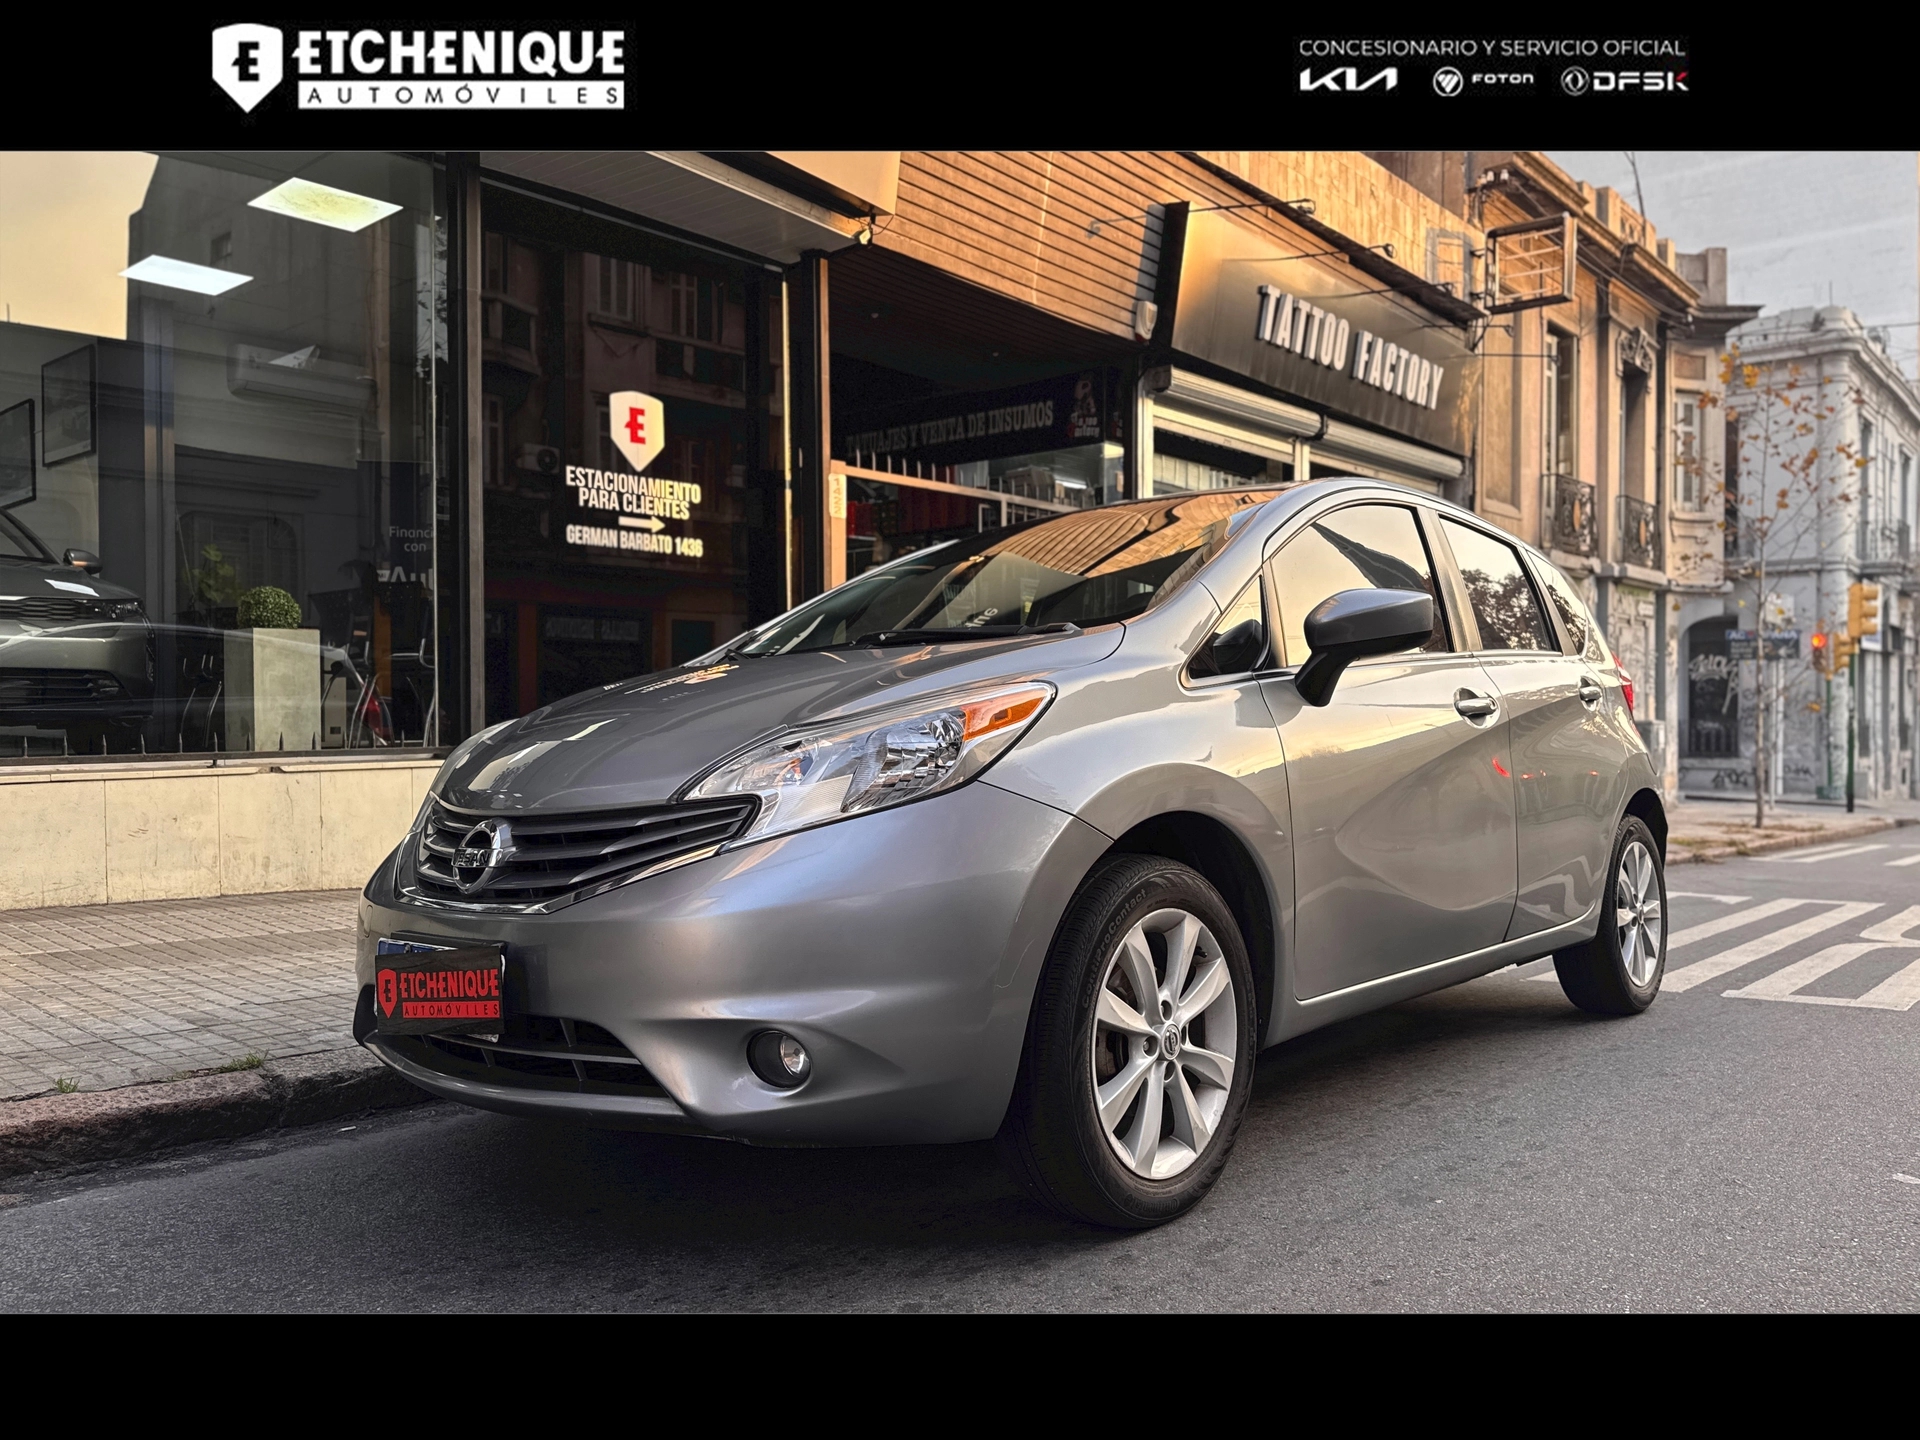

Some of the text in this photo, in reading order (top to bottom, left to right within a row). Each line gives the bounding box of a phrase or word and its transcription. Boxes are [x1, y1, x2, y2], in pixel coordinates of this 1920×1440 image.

[1258, 284, 1445, 411] TATTOO FACTORY
[909, 423, 920, 447] Y
[920, 416, 963, 446] VENTA
[967, 411, 986, 438] DE
[987, 400, 1054, 434] INSUMOS
[565, 465, 702, 504] ESTACIONAMIENTO
[578, 487, 690, 520] PARA CLIENTES
[404, 543, 427, 552] con
[566, 524, 704, 558] GERMAN BARBATO 1436
[399, 968, 499, 999] ETCHENIQUE
[404, 1003, 499, 1016] AUTOMÓVILES
